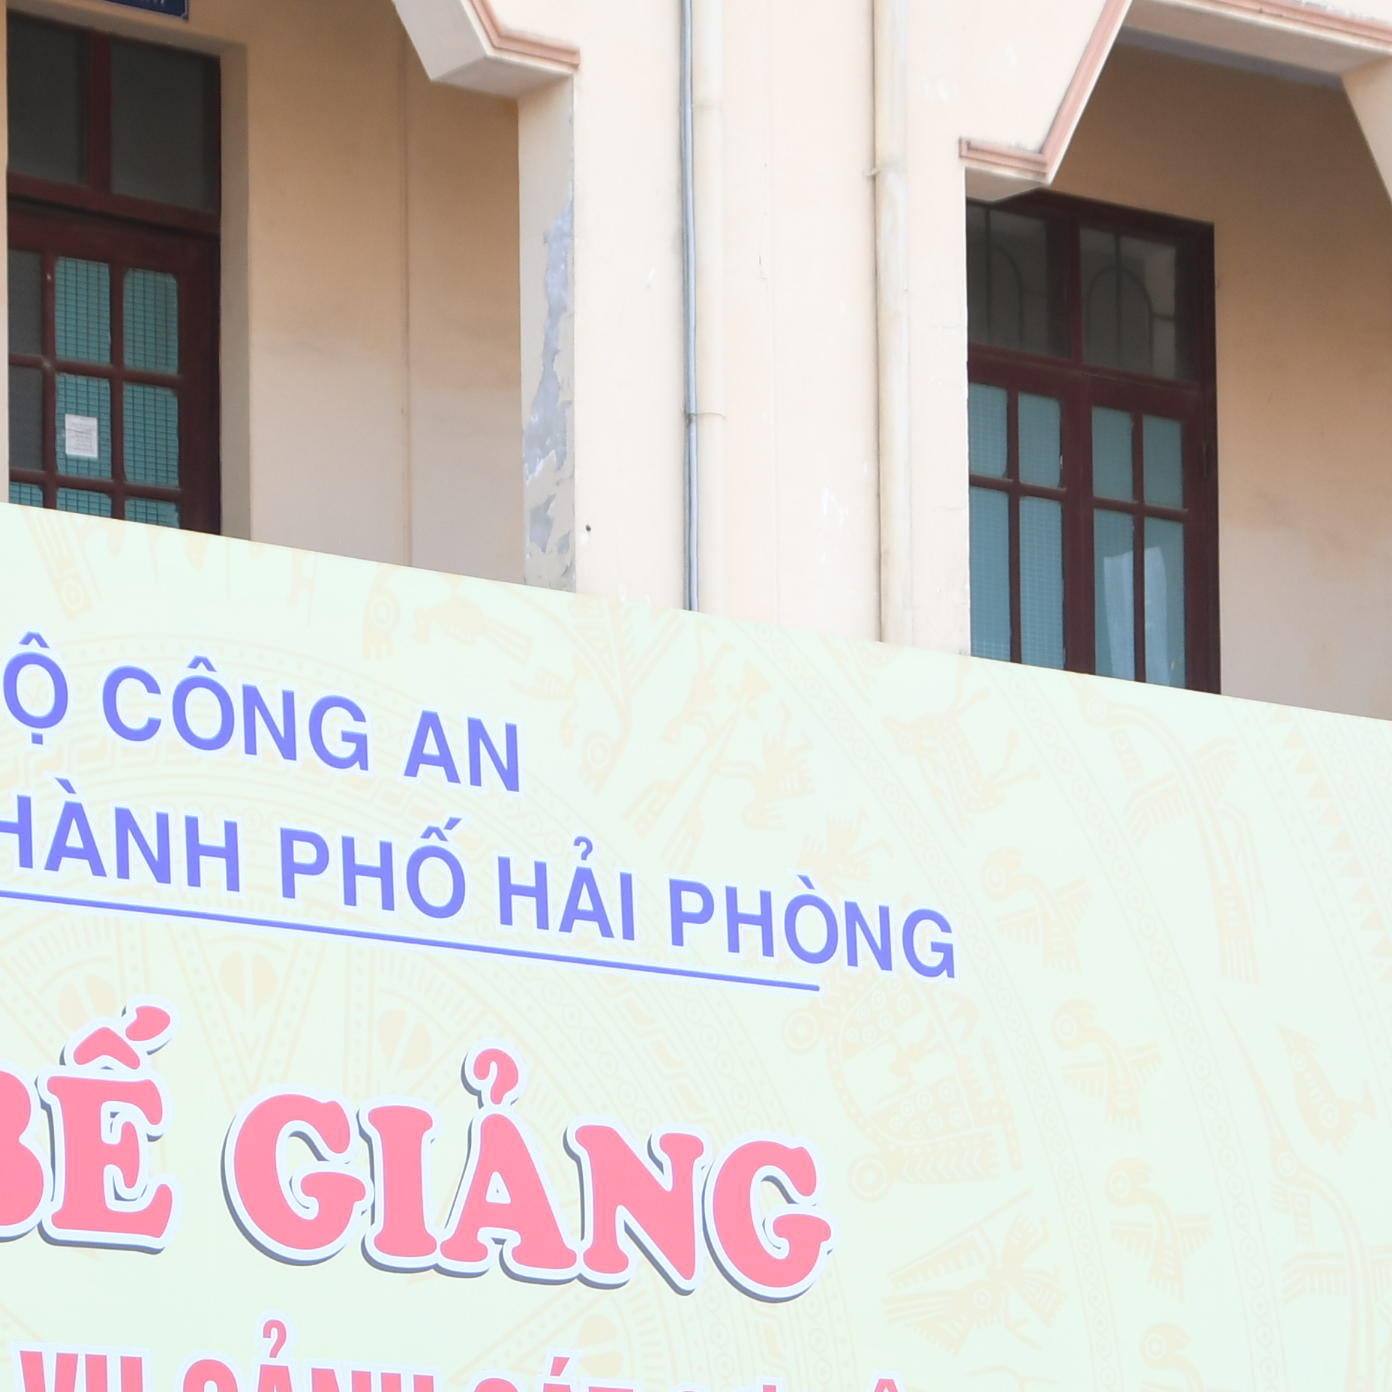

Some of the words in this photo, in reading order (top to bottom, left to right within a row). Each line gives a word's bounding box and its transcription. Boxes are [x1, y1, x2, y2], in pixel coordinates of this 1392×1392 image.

[101, 656, 369, 772] CÔNG
[403, 709, 520, 793] AN
[279, 822, 466, 924] PHỐ
[497, 836, 636, 942] HẢI
[668, 874, 956, 979] PHÒNG
[234, 1049, 832, 1290] GIẢNG
